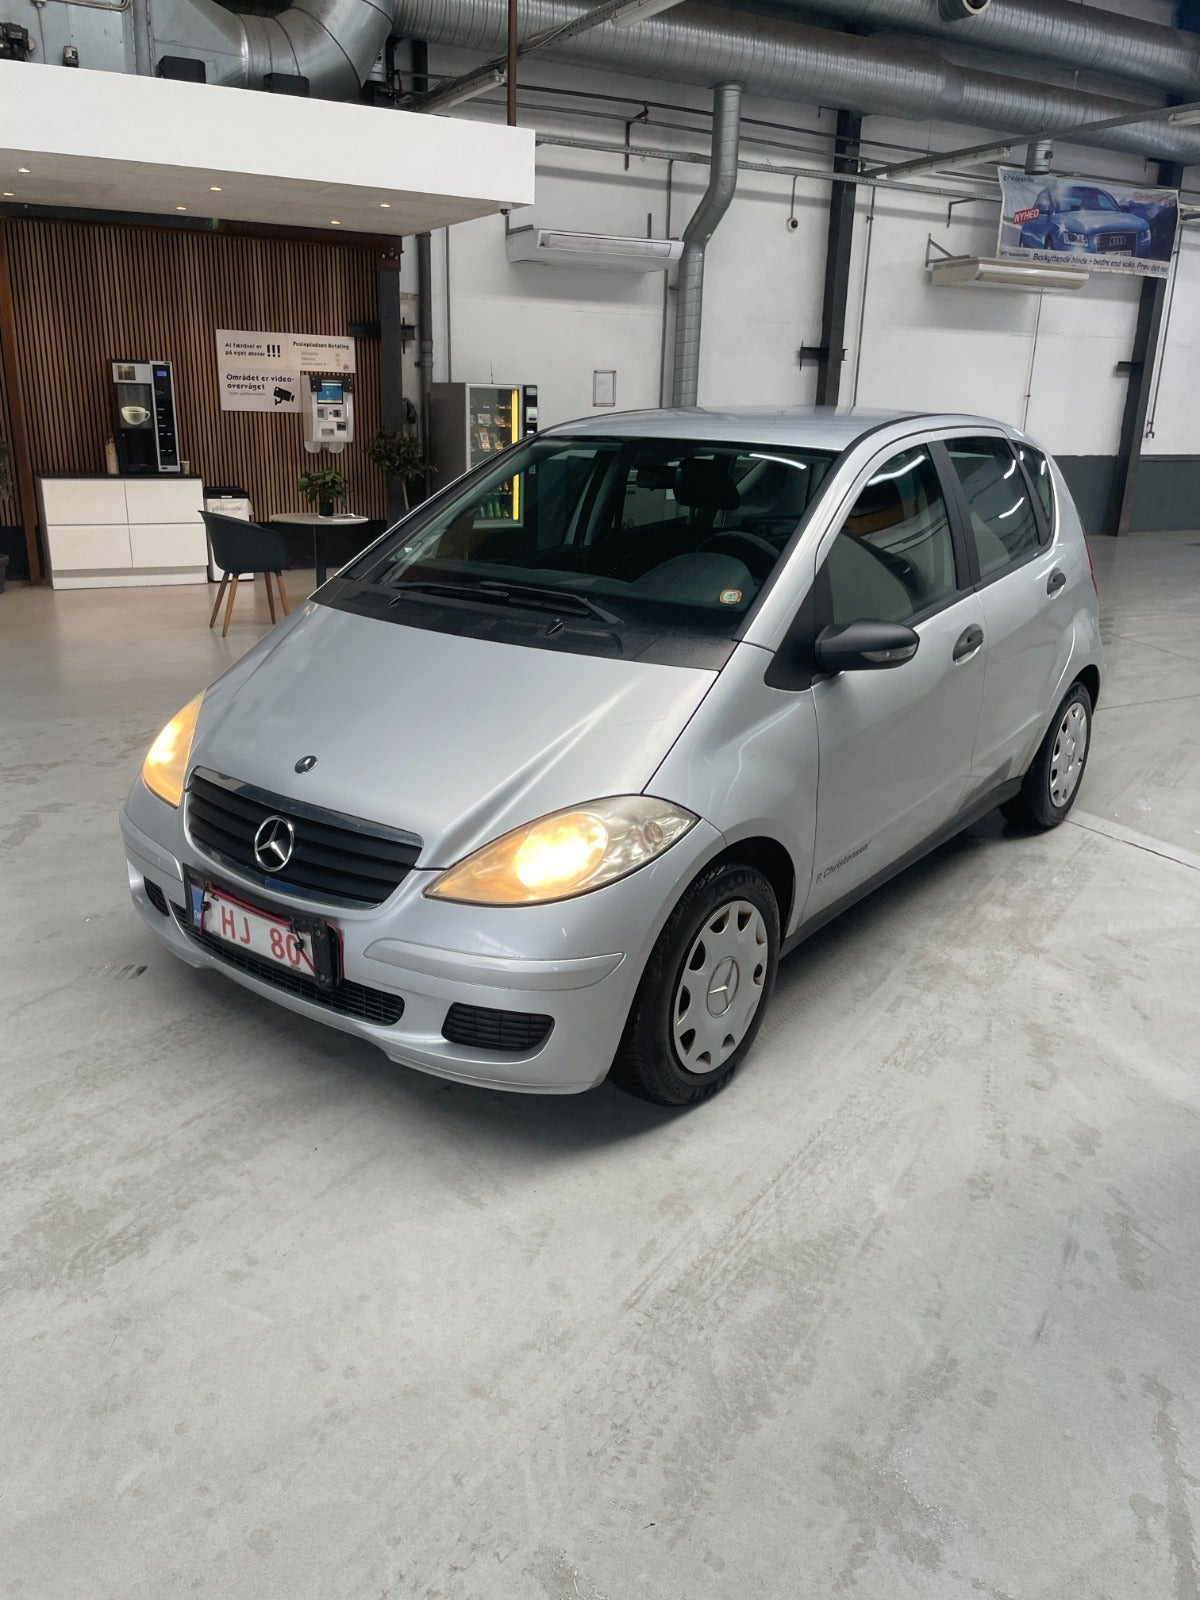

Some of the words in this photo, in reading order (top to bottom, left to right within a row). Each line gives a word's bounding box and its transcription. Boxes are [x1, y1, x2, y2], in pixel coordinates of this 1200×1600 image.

[1014, 208, 1039, 223] NYHED
[1032, 253, 1071, 264] Beskyttende
[1093, 258, 1109, 267] bedre
[1110, 260, 1121, 268] end
[233, 342, 255, 350] færdsel
[328, 342, 350, 351] Betaling
[226, 373, 259, 382] Området
[270, 375, 295, 383] video-
[226, 383, 265, 391] overvåget
[219, 905, 251, 945] HJ
